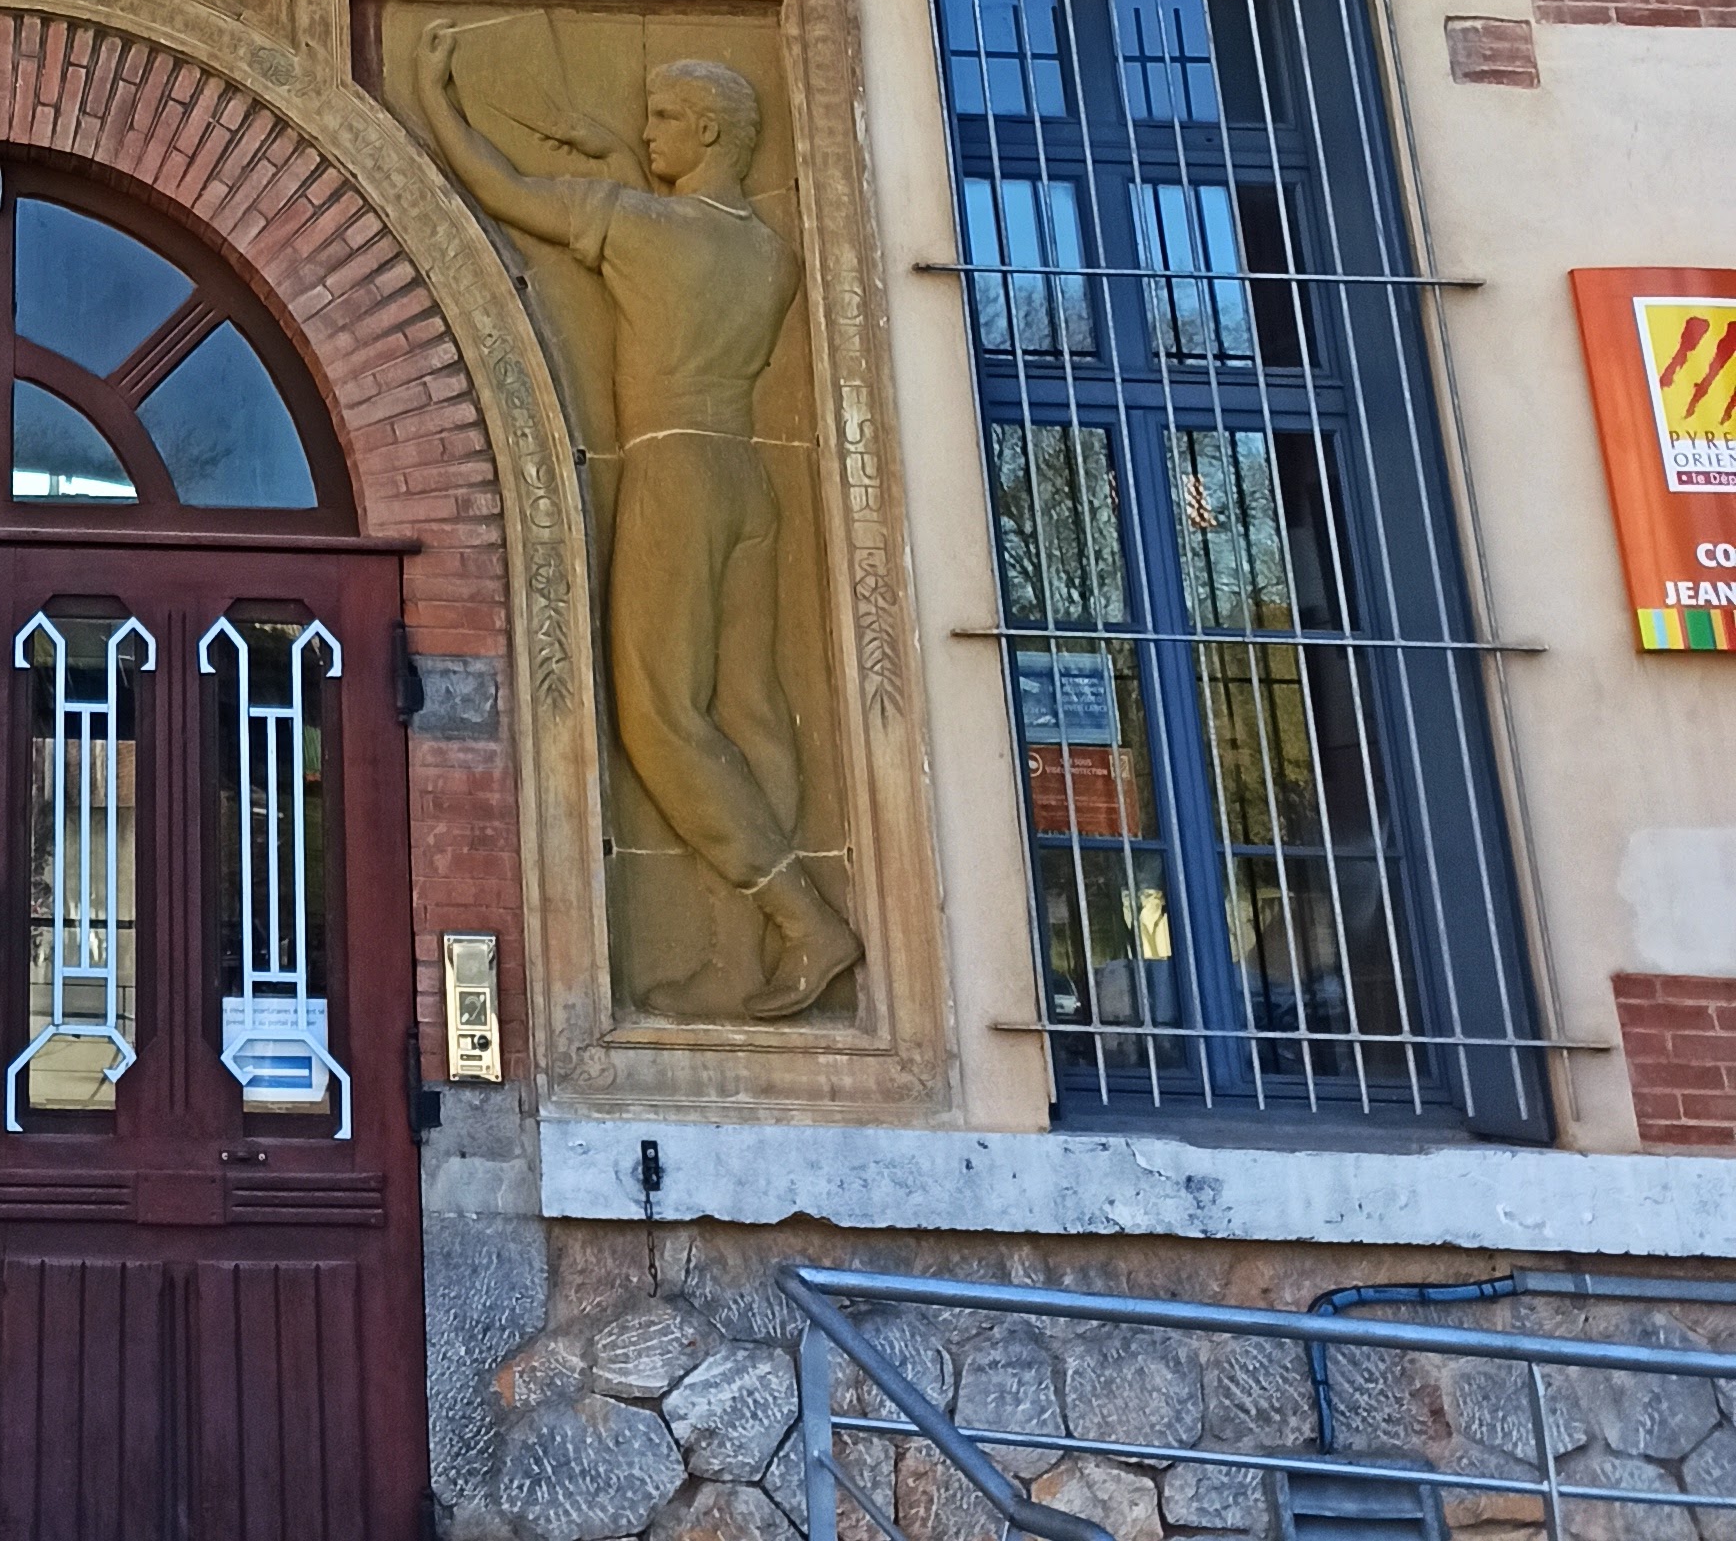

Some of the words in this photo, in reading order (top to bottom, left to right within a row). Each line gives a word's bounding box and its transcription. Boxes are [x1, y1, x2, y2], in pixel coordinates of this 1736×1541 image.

[840, 379, 889, 555] ESPRIT
[1696, 542, 1736, 568] CO
[1665, 580, 1736, 606] JEAN
